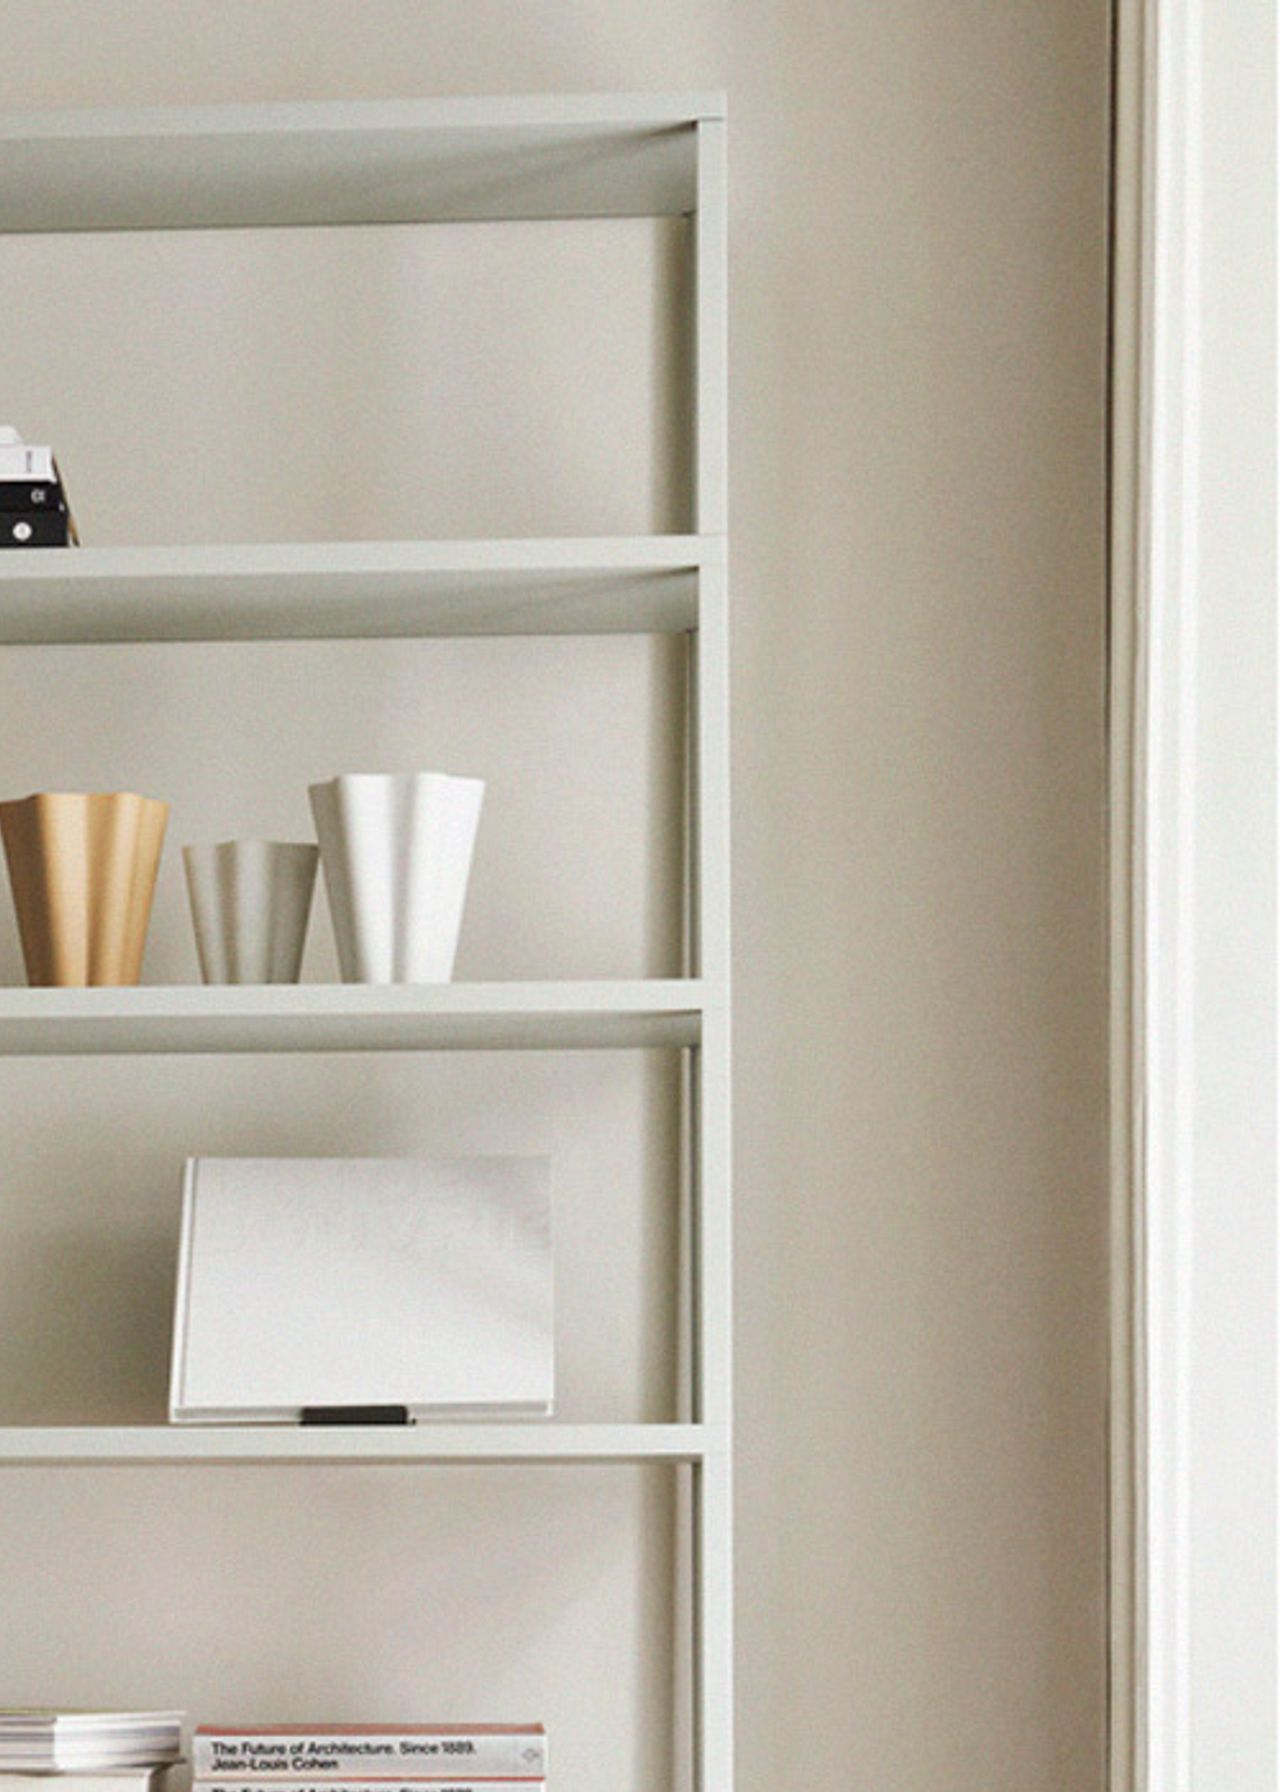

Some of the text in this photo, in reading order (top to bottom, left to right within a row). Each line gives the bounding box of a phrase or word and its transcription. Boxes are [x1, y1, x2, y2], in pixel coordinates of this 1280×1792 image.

[211, 1742, 237, 1754] The
[242, 1742, 286, 1754] Future
[290, 1742, 304, 1754] of
[307, 1742, 396, 1754] Architecture.
[400, 1741, 438, 1754] Since
[211, 1758, 338, 1771] Jean-Louis Cohen
